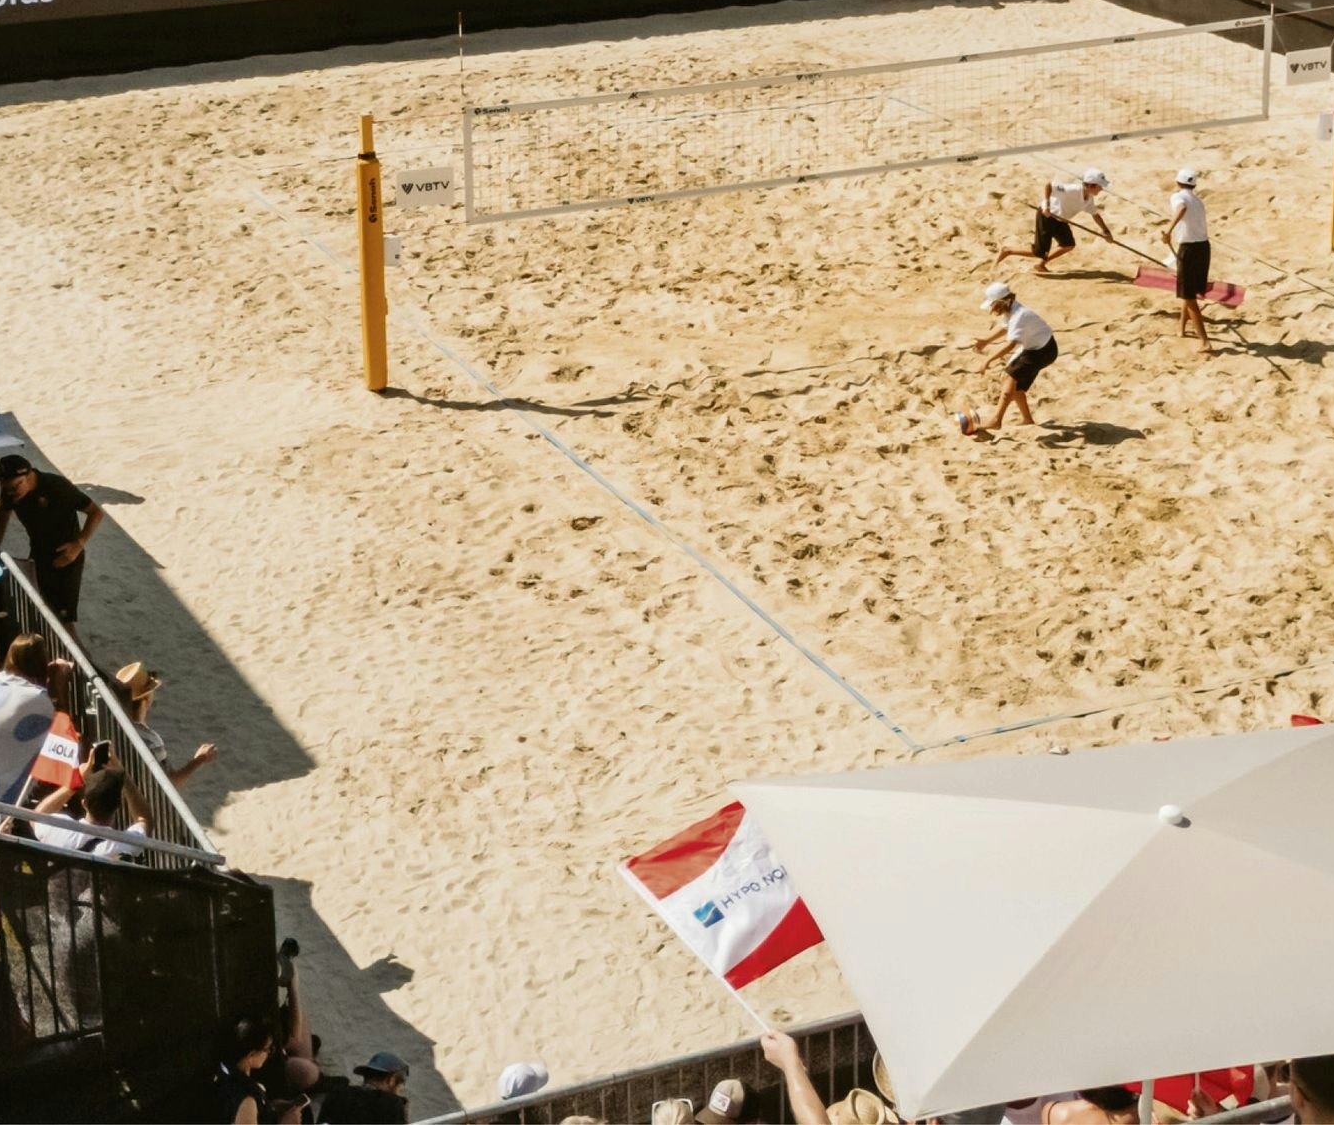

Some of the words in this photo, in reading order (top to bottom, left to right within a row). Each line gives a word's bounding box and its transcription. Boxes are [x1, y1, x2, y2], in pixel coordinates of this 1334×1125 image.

[1301, 61, 1327, 72] VBTV
[416, 181, 450, 192] VBTV
[722, 881, 760, 910] HYPO
